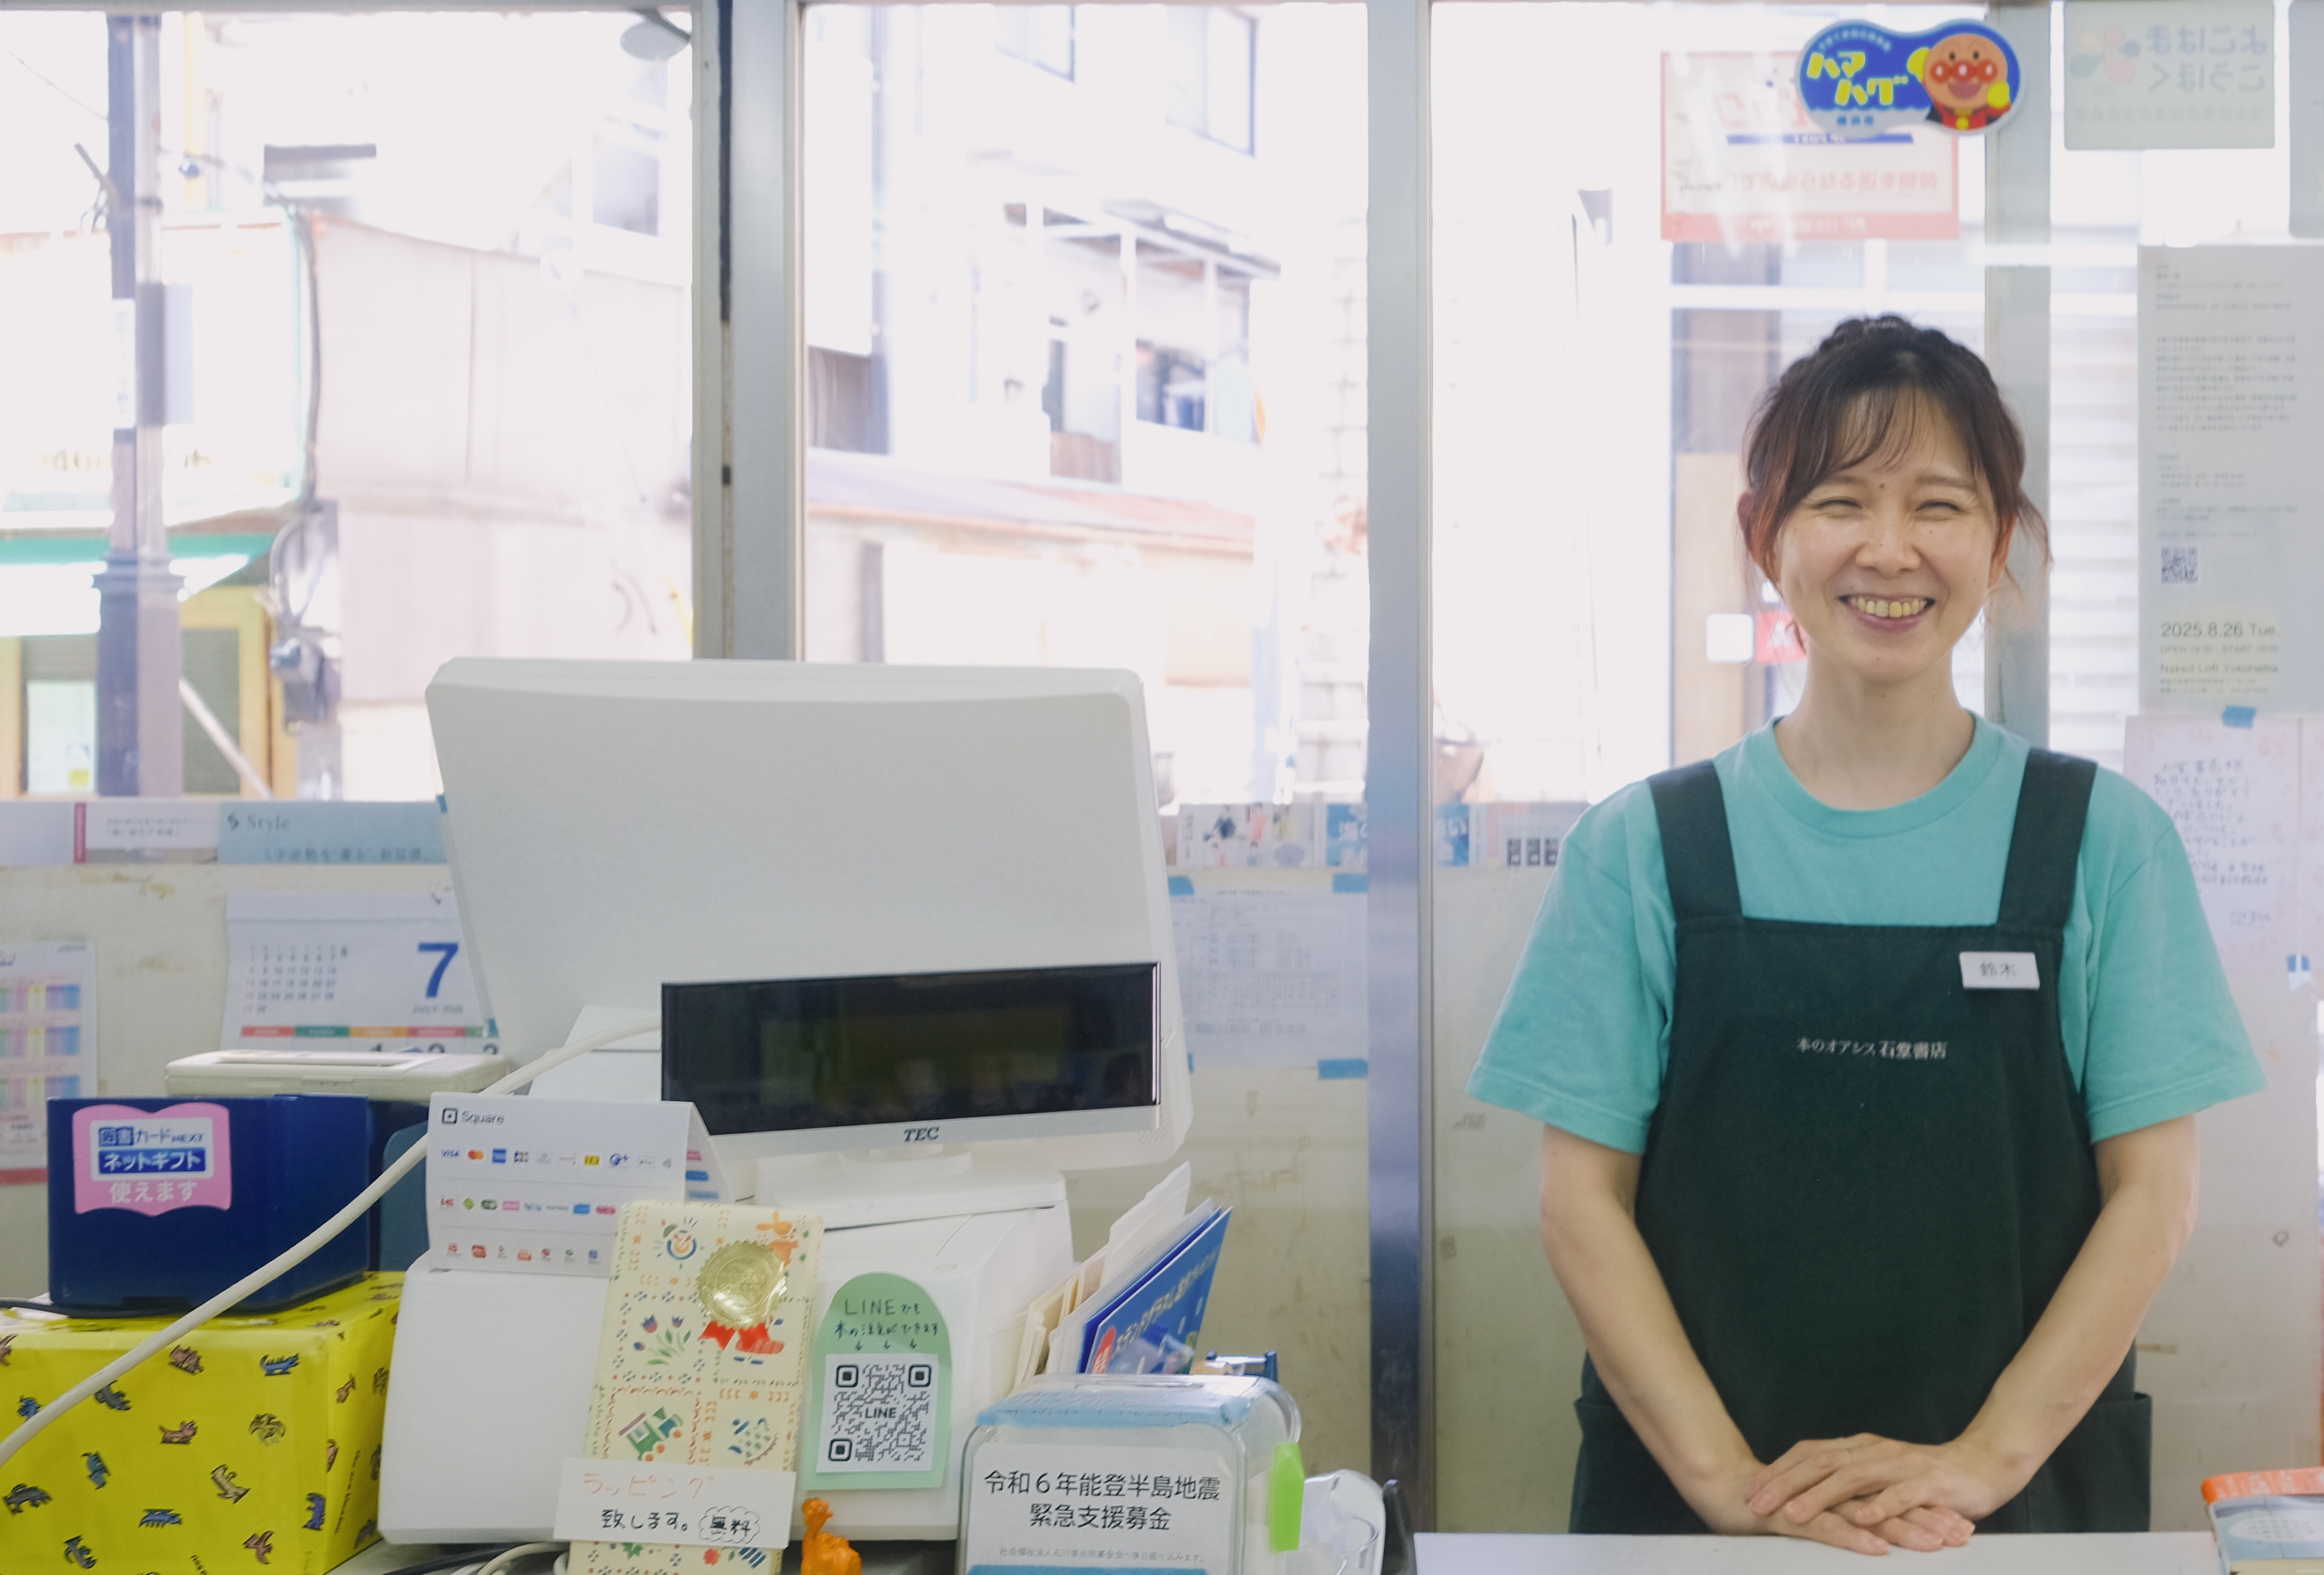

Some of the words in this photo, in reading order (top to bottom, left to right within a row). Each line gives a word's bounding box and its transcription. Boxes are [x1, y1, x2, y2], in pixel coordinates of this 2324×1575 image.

[1807, 52, 1865, 78] ハマ
[1835, 76, 1908, 105] ハグ
[2161, 622, 2244, 638] 2025.8.26
[2250, 624, 2279, 637] Tue.
[2223, 663, 2279, 673] Yokohama
[245, 815, 291, 832] Style
[418, 942, 458, 999] 7
[1980, 961, 2016, 978] 鈴木
[1797, 1037, 1875, 1058] 本のオアシス
[1878, 1040, 1948, 1060] 石堂書店
[461, 1110, 505, 1125] Square
[904, 1127, 940, 1143] TEC
[103, 1150, 201, 1172] ネットギフト
[441, 1149, 461, 1159] VISA
[109, 1180, 198, 1204] 使えます
[865, 1407, 897, 1419] LINE
[583, 1472, 715, 1500] ラッピング
[984, 1469, 1221, 1502] 令和6年能登半島地震
[1029, 1502, 1172, 1532] 緊急支援募金
